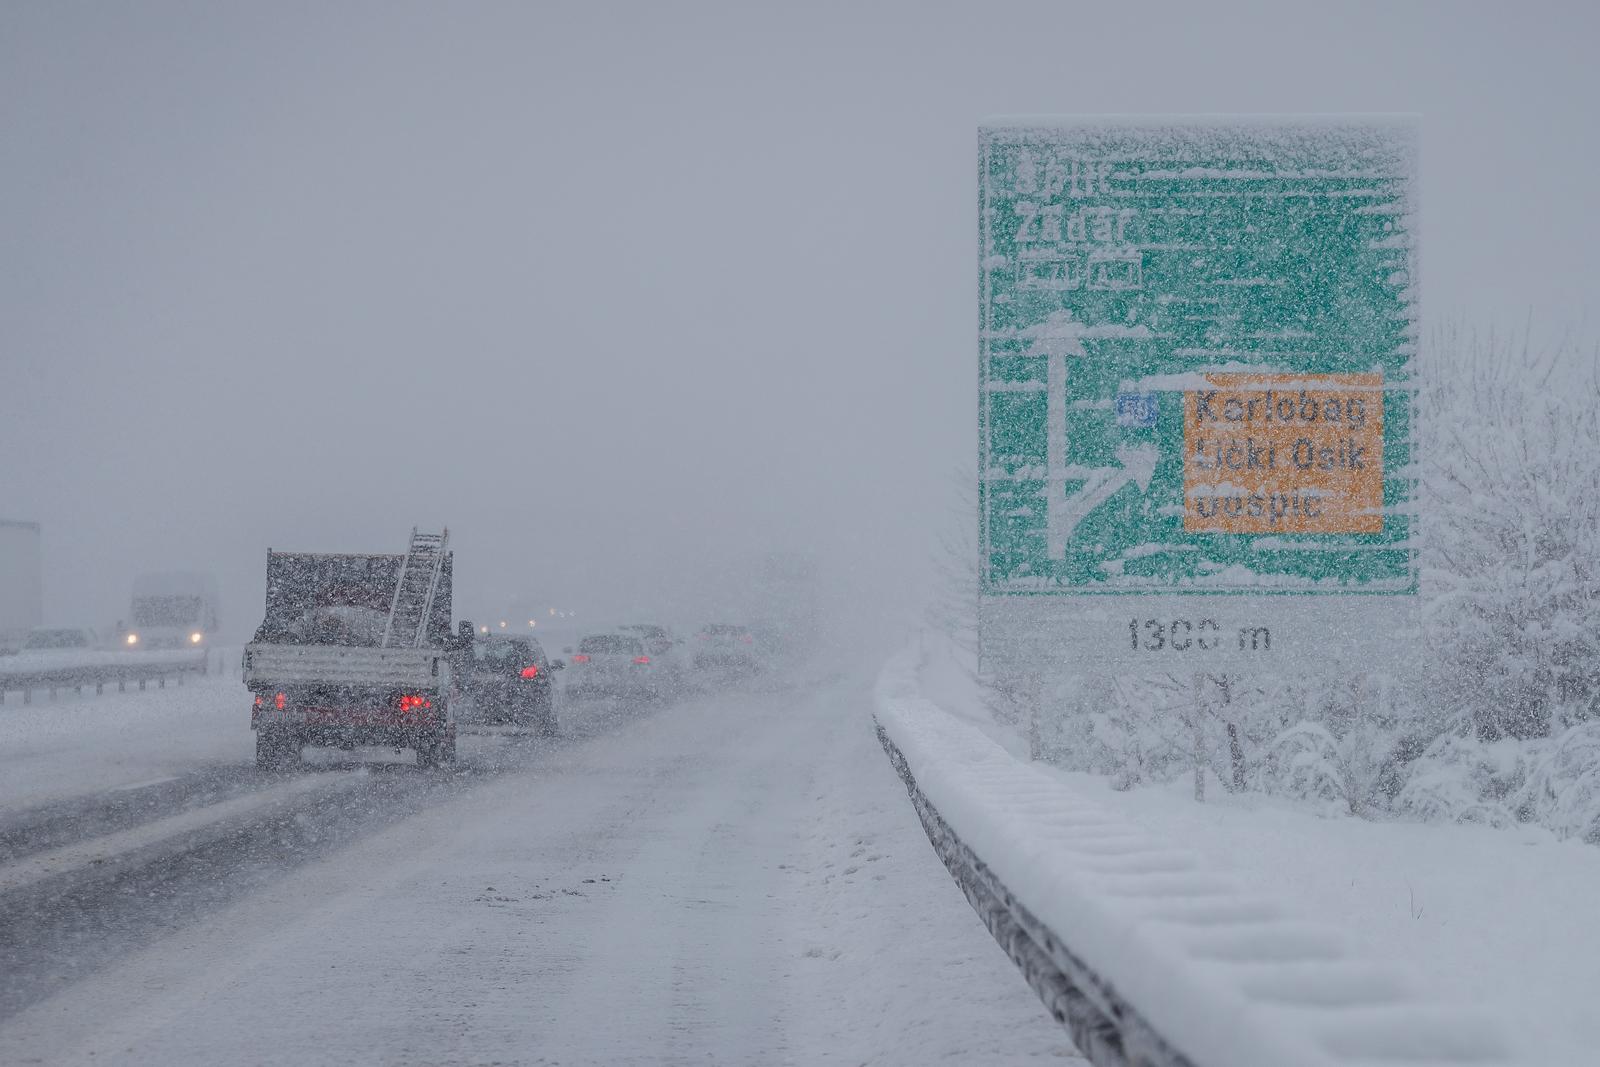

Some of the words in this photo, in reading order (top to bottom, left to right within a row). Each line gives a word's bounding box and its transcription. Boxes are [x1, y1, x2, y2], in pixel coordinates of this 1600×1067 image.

[1197, 389, 1366, 430] Karlobag
[1293, 437, 1366, 470] Osik
[1128, 617, 1221, 651] 1300
[1239, 626, 1272, 651] m
